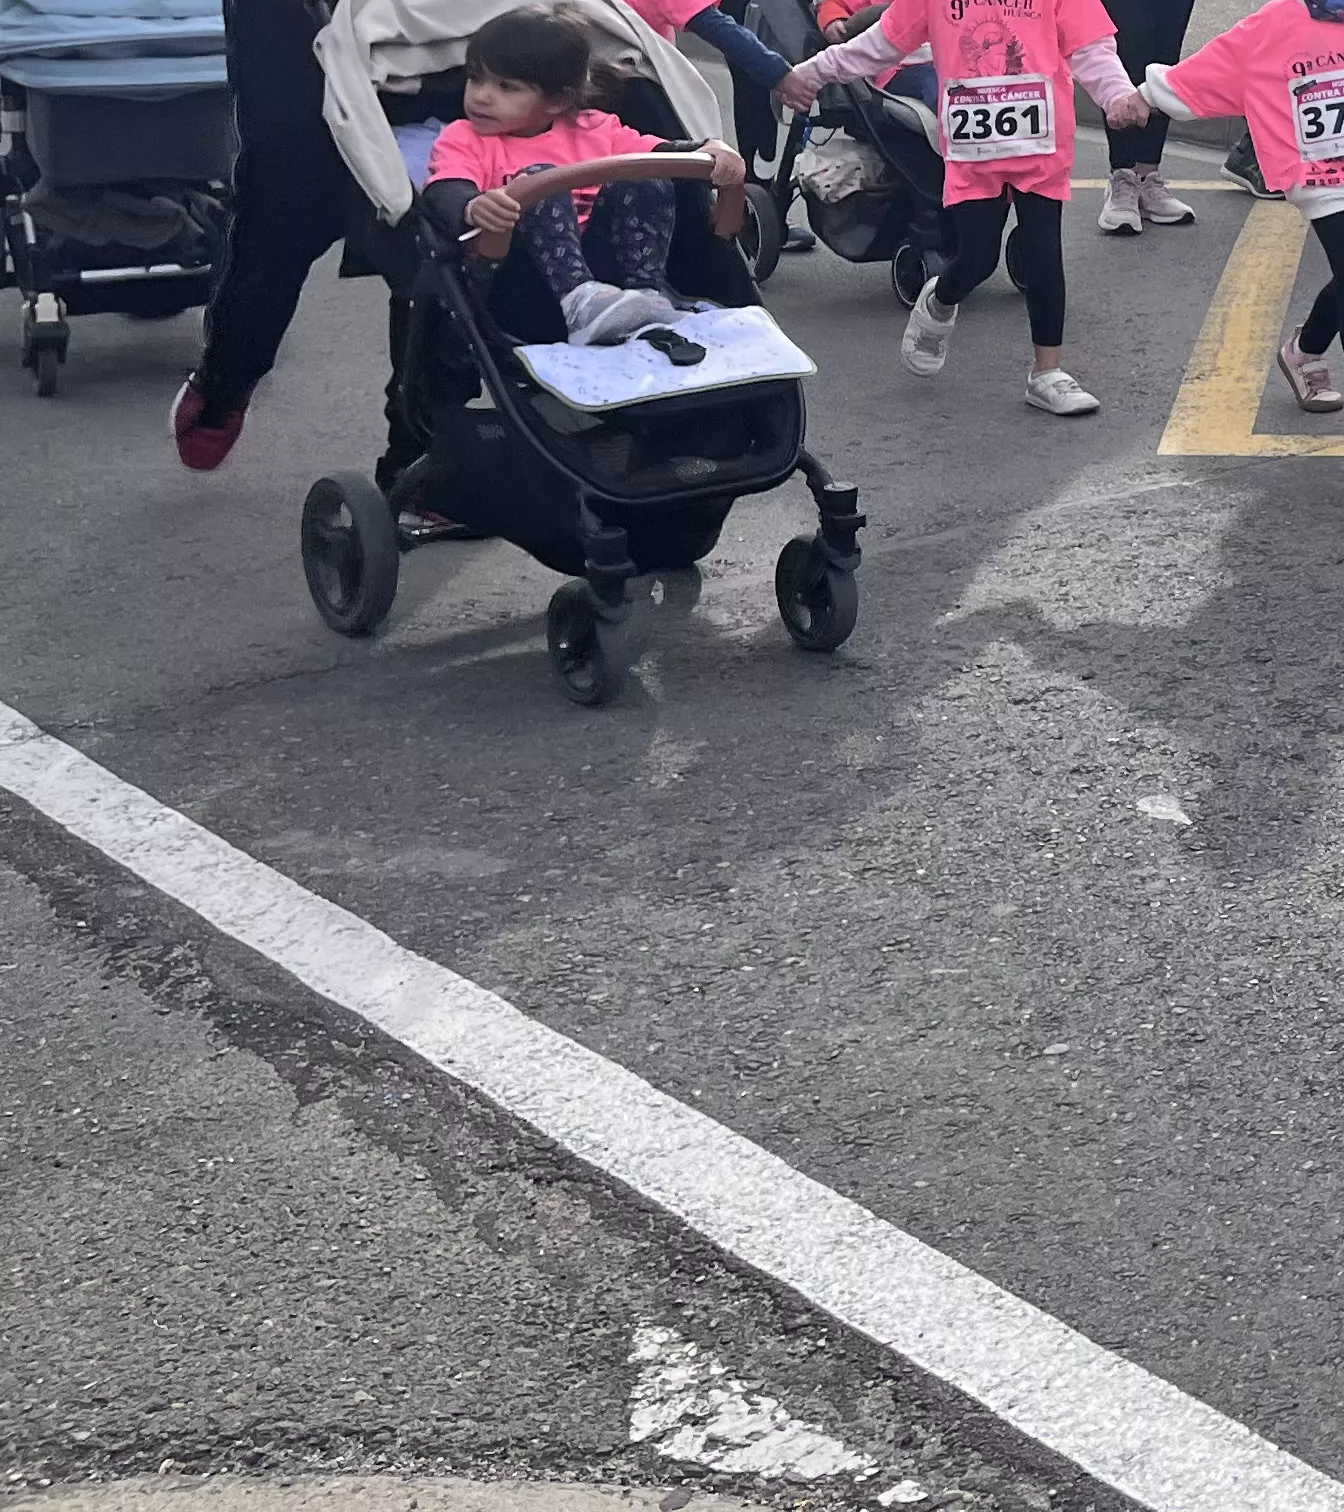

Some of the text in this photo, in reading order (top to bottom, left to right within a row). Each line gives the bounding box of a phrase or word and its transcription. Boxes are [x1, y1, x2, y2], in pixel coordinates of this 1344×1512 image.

[1000, 90, 1041, 101] CÁNCER
[1301, 89, 1341, 103] CONTRA
[950, 105, 1041, 140] 2361
